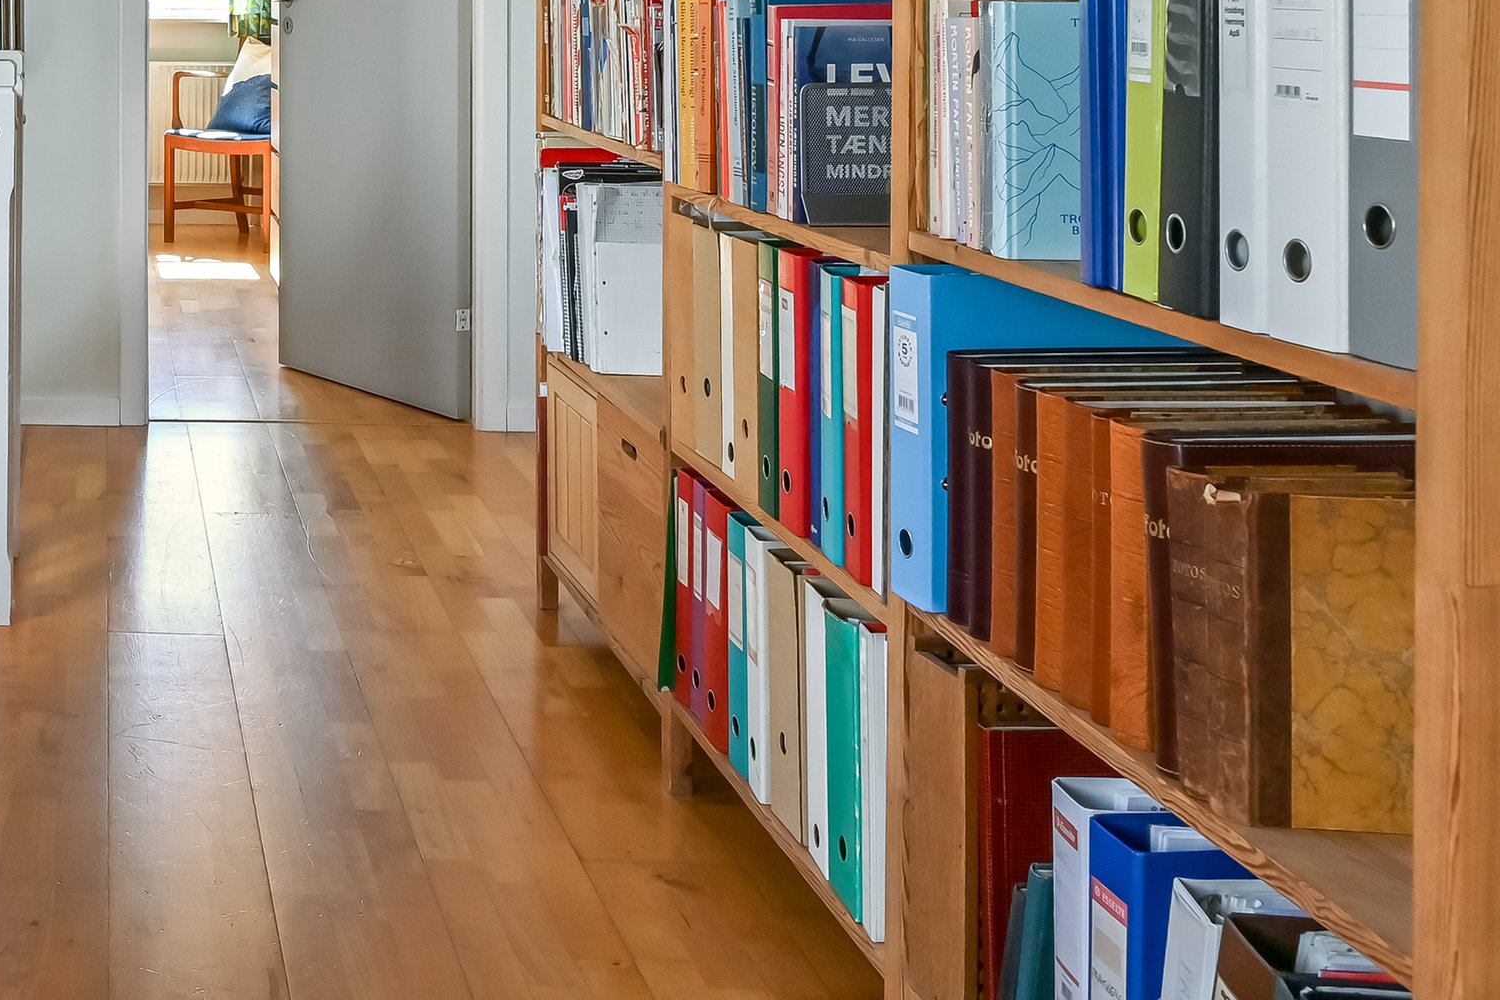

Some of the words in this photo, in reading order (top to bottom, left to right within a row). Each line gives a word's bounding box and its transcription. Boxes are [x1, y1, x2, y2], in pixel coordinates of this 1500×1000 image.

[1224, 7, 1245, 16] Holding
[1229, 29, 1240, 37] ApS
[950, 25, 959, 91] MORTEN
[964, 27, 973, 94] MORTEN
[952, 98, 960, 140] PAPE
[965, 101, 974, 145] PAPE
[826, 135, 892, 154] TÆN
[777, 150, 786, 197] ANGST
[901, 342, 908, 355] 5
[1101, 892, 1126, 921] ESSELTE
